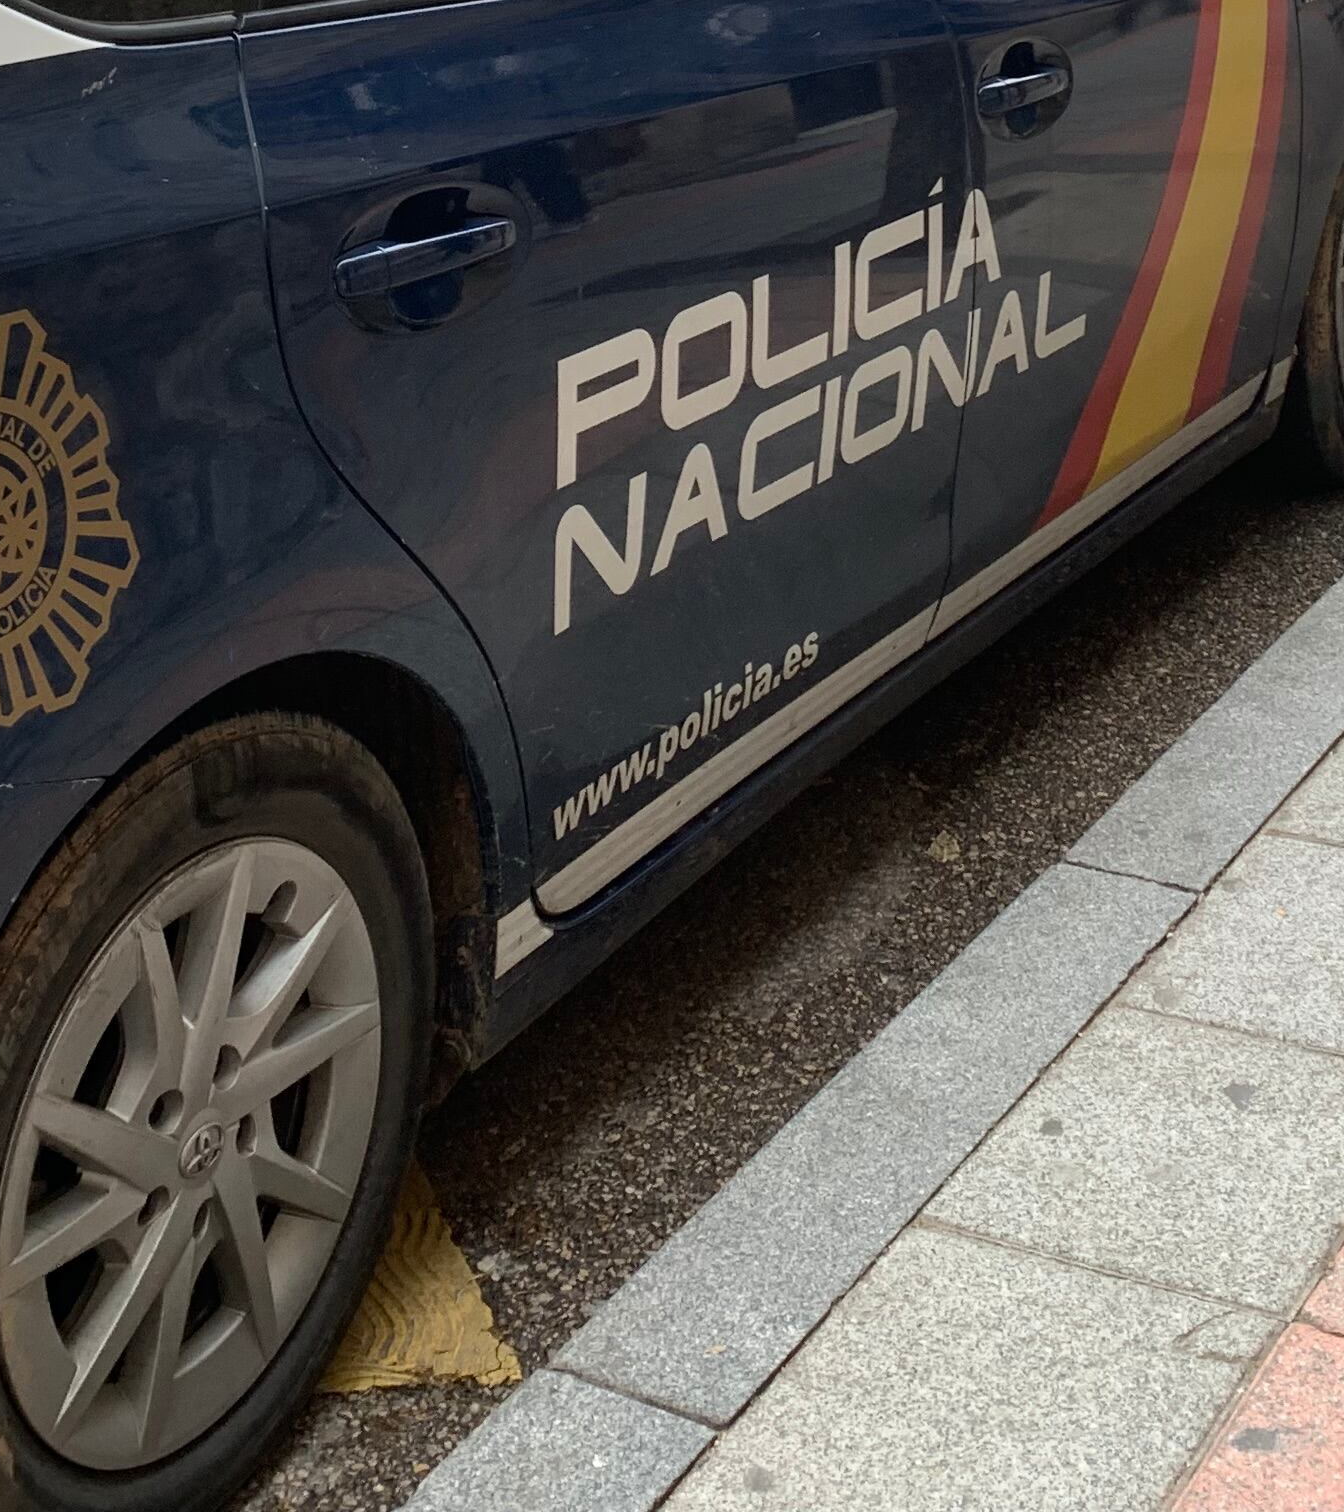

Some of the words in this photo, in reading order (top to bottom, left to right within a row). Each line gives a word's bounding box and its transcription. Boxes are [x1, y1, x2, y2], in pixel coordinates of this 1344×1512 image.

[27, 438, 57, 478] DE
[554, 271, 1087, 636] NACIONAL
[556, 175, 1002, 490] POLICÍA
[552, 631, 820, 841] www.policia.es
